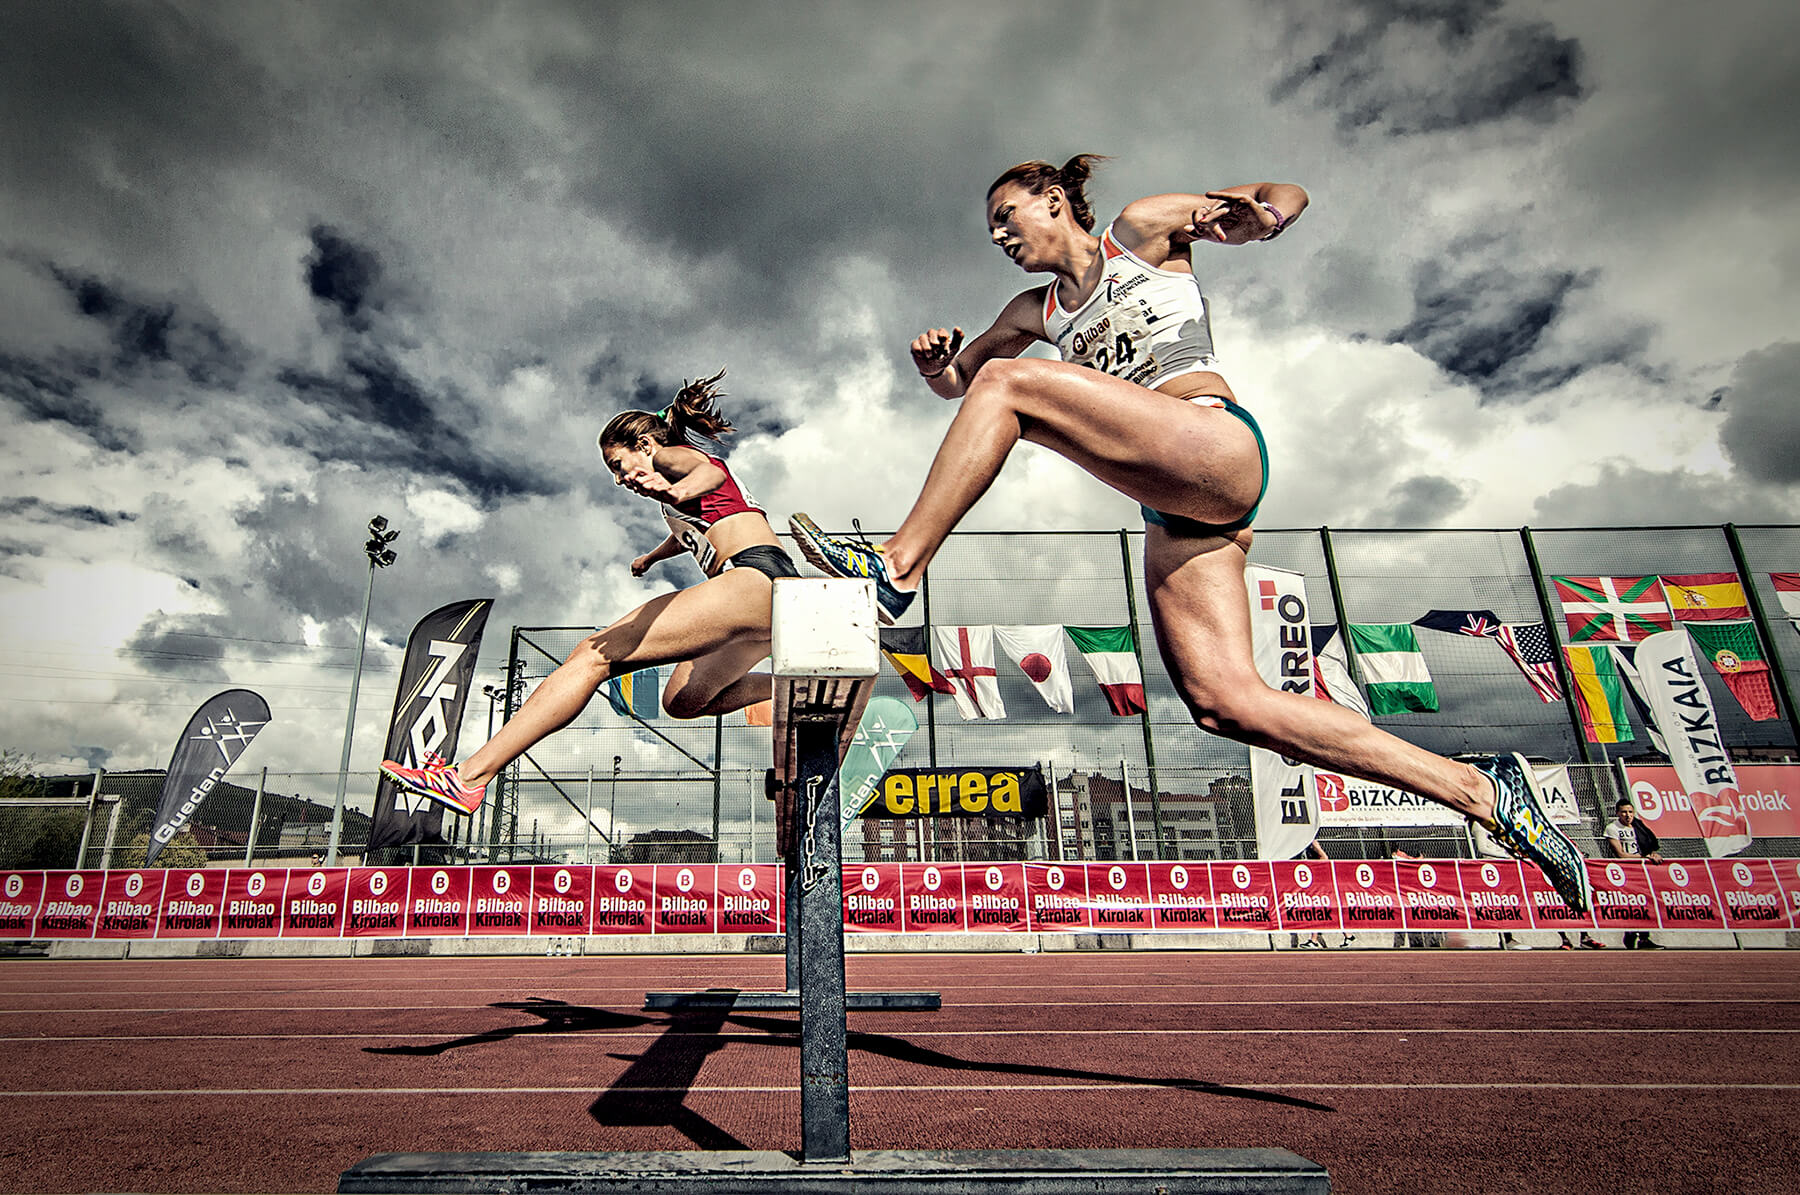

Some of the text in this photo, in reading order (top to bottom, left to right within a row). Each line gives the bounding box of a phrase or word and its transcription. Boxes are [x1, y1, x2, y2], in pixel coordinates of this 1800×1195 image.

[1072, 317, 1110, 356] Bilbao
[1081, 331, 1138, 374] 24
[1661, 656, 1735, 786] BIZKAIA
[153, 766, 226, 844] Guedan
[841, 773, 880, 830] edan
[1281, 774, 1311, 825] EL
[1635, 786, 1792, 814] Bilb rolak
[476, 899, 522, 913] Bilbao
[538, 898, 584, 912] Bilbao
[600, 898, 645, 912] Bilbao
[662, 897, 707, 912] Bilbao
[724, 896, 769, 911] Bilbao
[848, 896, 894, 910] Bilbao
[911, 896, 956, 910] Bilbao
[973, 895, 1018, 910] Bilbao
[1035, 895, 1080, 909] Bilbao
[1159, 894, 1204, 906] Bilbao
[1221, 893, 1268, 908] Bilbao
[1284, 892, 1330, 908] Bilbao
[1346, 892, 1392, 907] Bilbao
[1407, 892, 1455, 907] Bilbao
[1471, 891, 1518, 906] Bilbao
[1534, 891, 1564, 906] Bilb
[1597, 891, 1646, 906] Bilbao
[1661, 891, 1710, 906] Bilbao
[1725, 891, 1775, 906] Bilbao
[0, 903, 31, 916] lbao
[46, 902, 92, 916] Bilbao
[107, 901, 151, 916] Bilbao
[168, 901, 214, 916] Bilbao
[230, 901, 274, 916] Bilbao
[291, 900, 336, 914] Bilbao
[352, 900, 398, 914] Bilbao
[415, 899, 460, 914] Bilbao
[1287, 907, 1332, 921] Kirolak
[1349, 907, 1394, 921] Kirolak
[1411, 907, 1458, 921] Kirolak
[1475, 906, 1523, 921] Kirolak
[1601, 906, 1650, 921] Kirolak
[1666, 906, 1715, 921] Kirolak
[1730, 906, 1780, 921] Kirolak
[42, 916, 87, 929] Kirolak
[103, 916, 148, 929] Kirolak
[166, 916, 211, 929] Kirolak
[228, 915, 273, 929] Kirolak
[289, 914, 334, 928] Kirolak
[351, 914, 396, 928] Kirolak
[414, 914, 459, 928] Kirolak
[476, 913, 521, 927] Kirolak
[538, 912, 582, 927] Kirolak
[600, 912, 644, 926] Kirolak
[661, 912, 706, 926] Kirolak
[723, 911, 770, 926] Kirolak
[849, 909, 894, 924] Kirolak
[911, 909, 957, 924] Kirolak
[973, 909, 1019, 924] Kirolak
[1036, 909, 1081, 923] Kirolak
[1098, 909, 1143, 922] Kirolak
[1161, 908, 1207, 923] Kirolak
[1224, 908, 1271, 923] Kirolak
